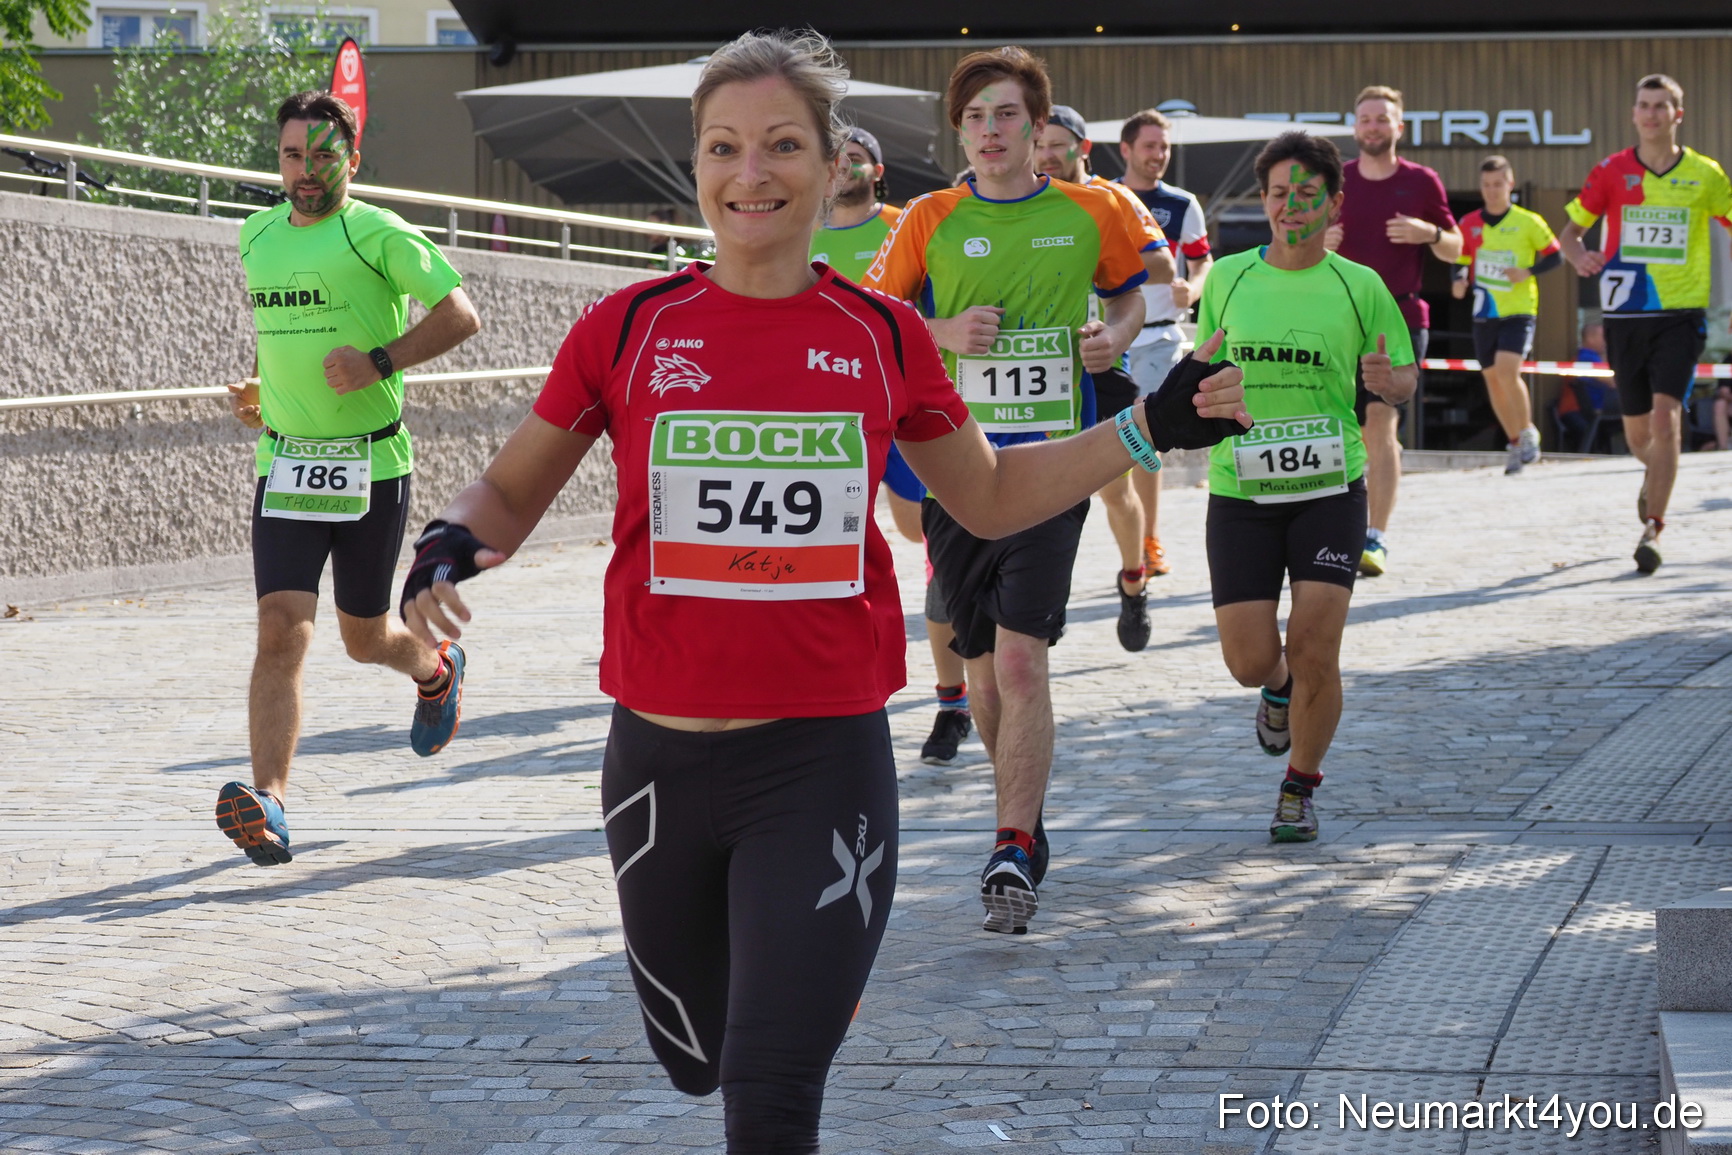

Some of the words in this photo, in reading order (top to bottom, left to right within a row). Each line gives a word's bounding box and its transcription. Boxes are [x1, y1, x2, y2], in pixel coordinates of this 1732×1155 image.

[1628, 208, 1682, 222] BOCK
[1032, 236, 1074, 248] BOCK
[1637, 227, 1673, 244] 173
[1608, 277, 1624, 306] 7
[672, 339, 704, 349] JAKO
[986, 332, 1062, 357] OCK
[1232, 346, 1325, 367] BRANDL
[807, 348, 862, 379] Kat
[982, 366, 1047, 396] 113
[994, 406, 1035, 420] NILS
[668, 421, 849, 461] BOCK
[1242, 419, 1332, 444] BOCK
[281, 441, 361, 457] BOCK
[1259, 445, 1321, 473] 184
[292, 465, 348, 491] 186
[1260, 480, 1326, 492] Marianne
[284, 496, 350, 512] THOMAS
[697, 480, 822, 535] 549
[728, 550, 796, 580] Katja
